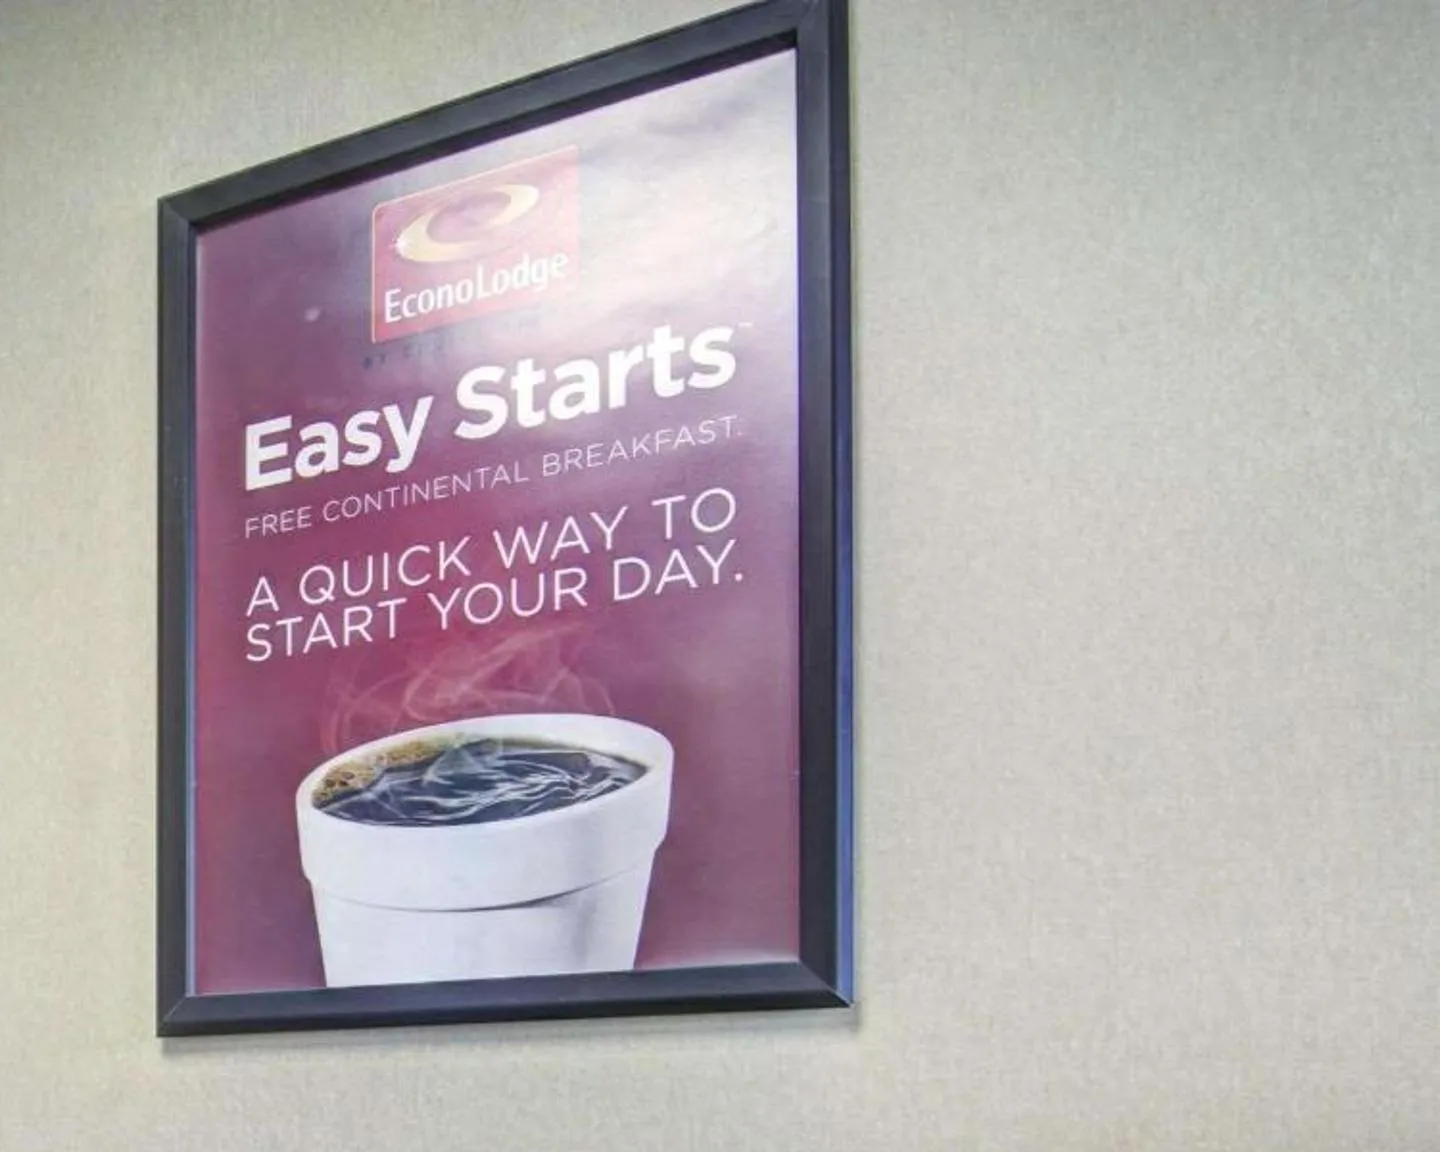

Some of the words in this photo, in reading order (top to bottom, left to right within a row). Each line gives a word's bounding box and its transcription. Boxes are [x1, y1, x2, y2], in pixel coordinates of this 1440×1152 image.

[383, 250, 569, 324] EconoLodge
[245, 395, 434, 491] Easy
[455, 323, 737, 440] Starts
[245, 506, 313, 539] FREE
[323, 460, 529, 522] CONTINENTAL
[245, 576, 280, 618] A
[298, 536, 472, 606] QUICK
[493, 505, 629, 570] WAY
[652, 486, 737, 540] TO
[245, 598, 407, 662] START
[427, 569, 588, 631] YOUR
[613, 539, 744, 602] DAY.
